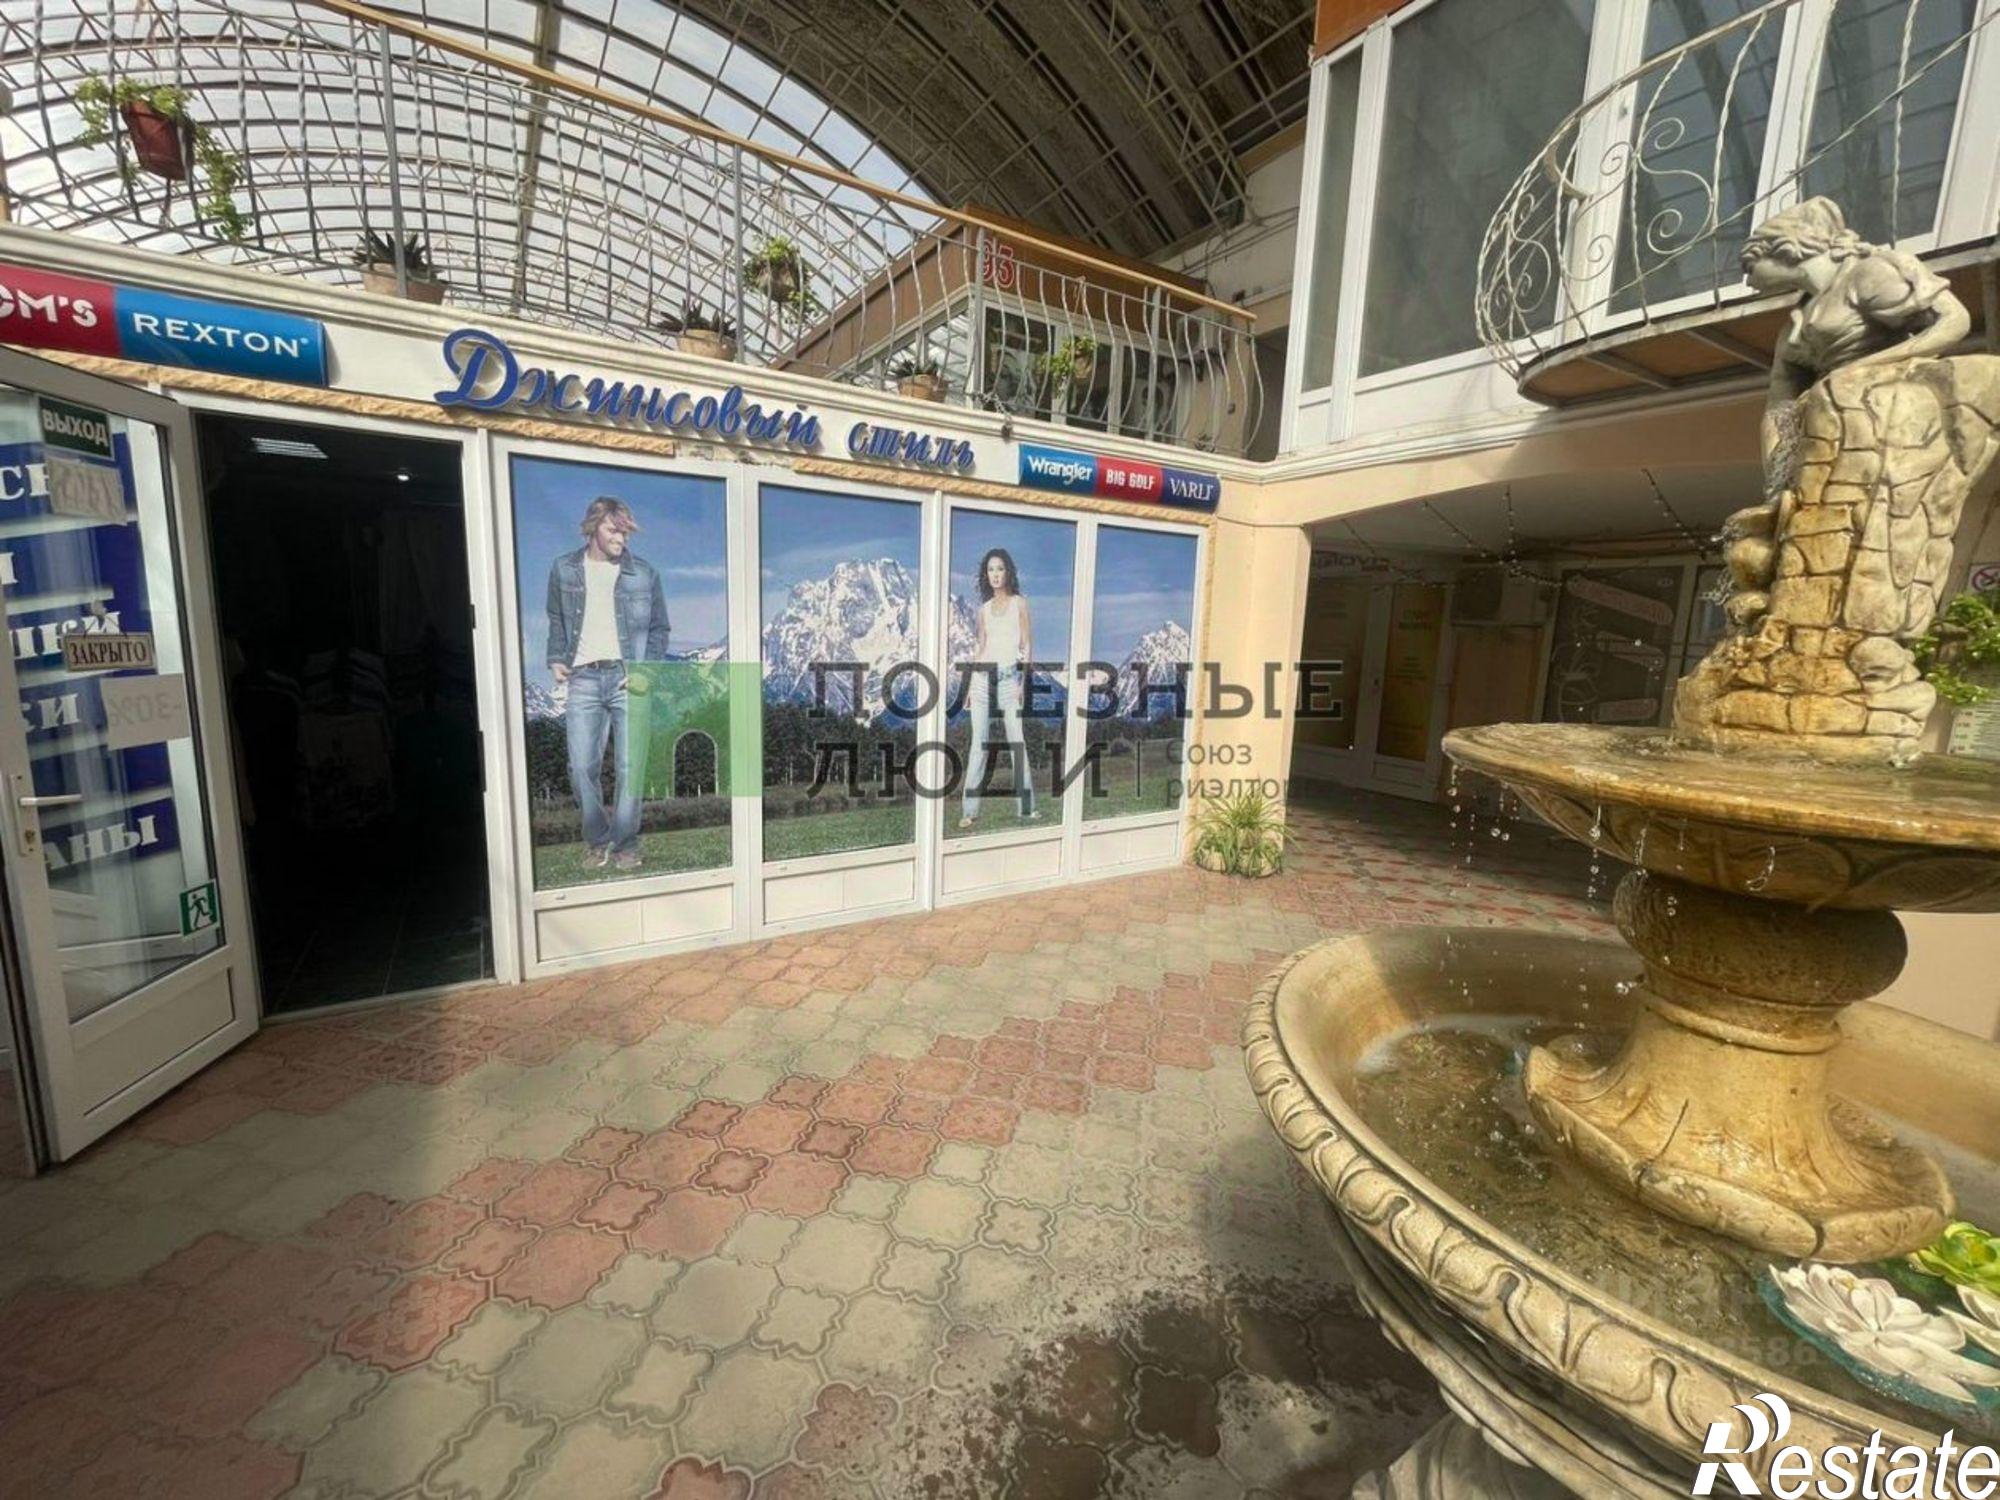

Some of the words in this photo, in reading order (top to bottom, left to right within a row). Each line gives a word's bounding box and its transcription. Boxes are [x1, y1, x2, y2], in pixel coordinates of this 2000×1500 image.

[132, 312, 300, 358] REXTON
[434, 328, 819, 446] Джинсовый
[42, 408, 110, 448] ВЫХОД
[1027, 454, 1093, 486] Wrangler
[1105, 469, 1126, 486] BIG
[1129, 473, 1156, 491] GOLF
[69, 640, 148, 665] ЗАКРЫТО
